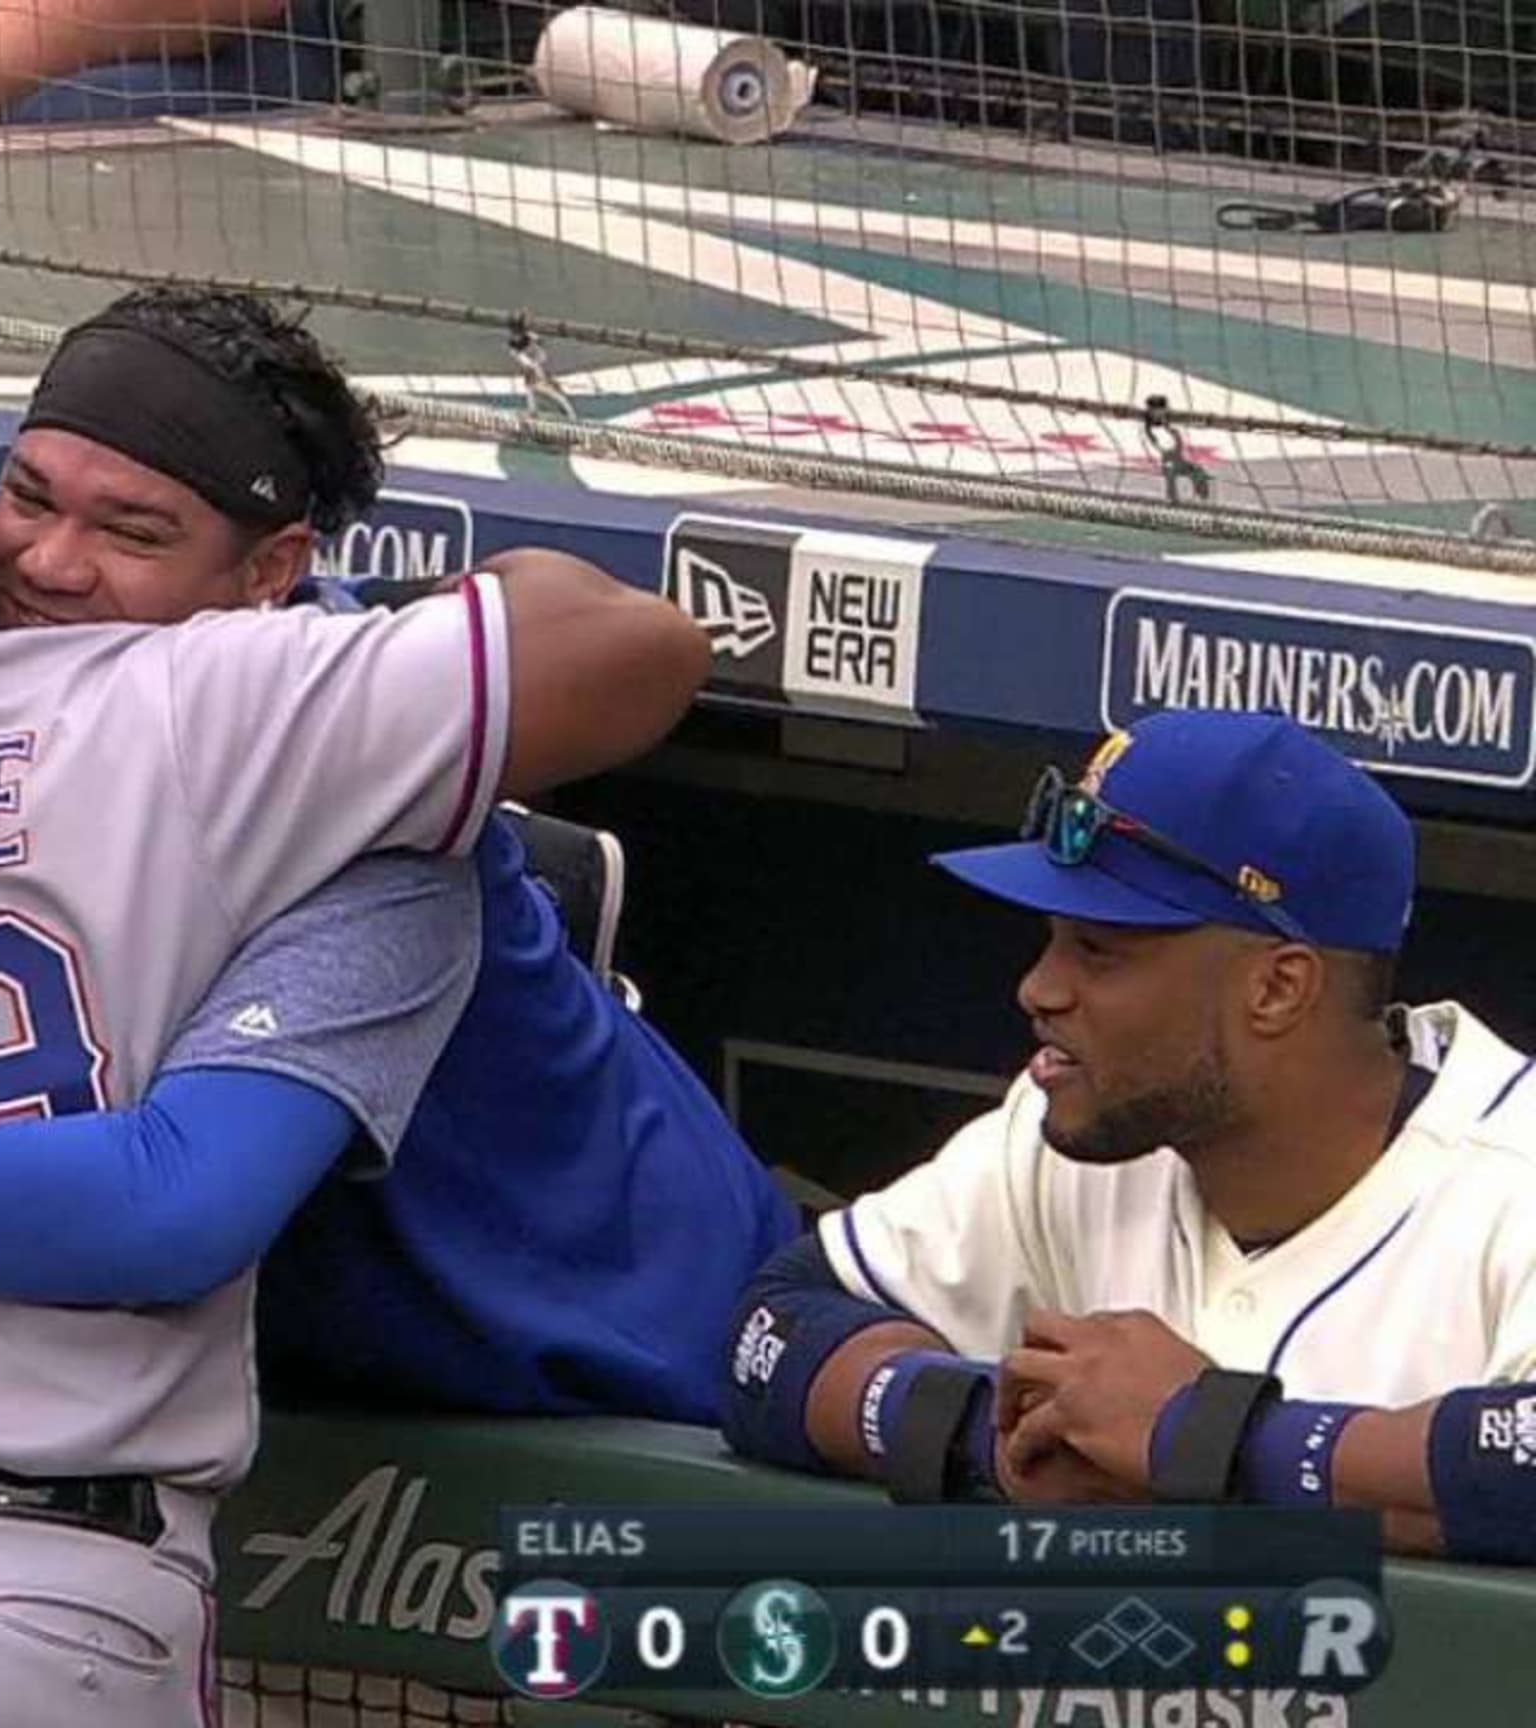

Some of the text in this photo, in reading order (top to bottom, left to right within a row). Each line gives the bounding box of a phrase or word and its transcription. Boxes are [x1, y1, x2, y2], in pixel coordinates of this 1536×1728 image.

[809, 570, 901, 631] NEW
[806, 627, 896, 688] ERA
[1479, 1409, 1512, 1448] 22
[240, 1465, 501, 1640] Alas
